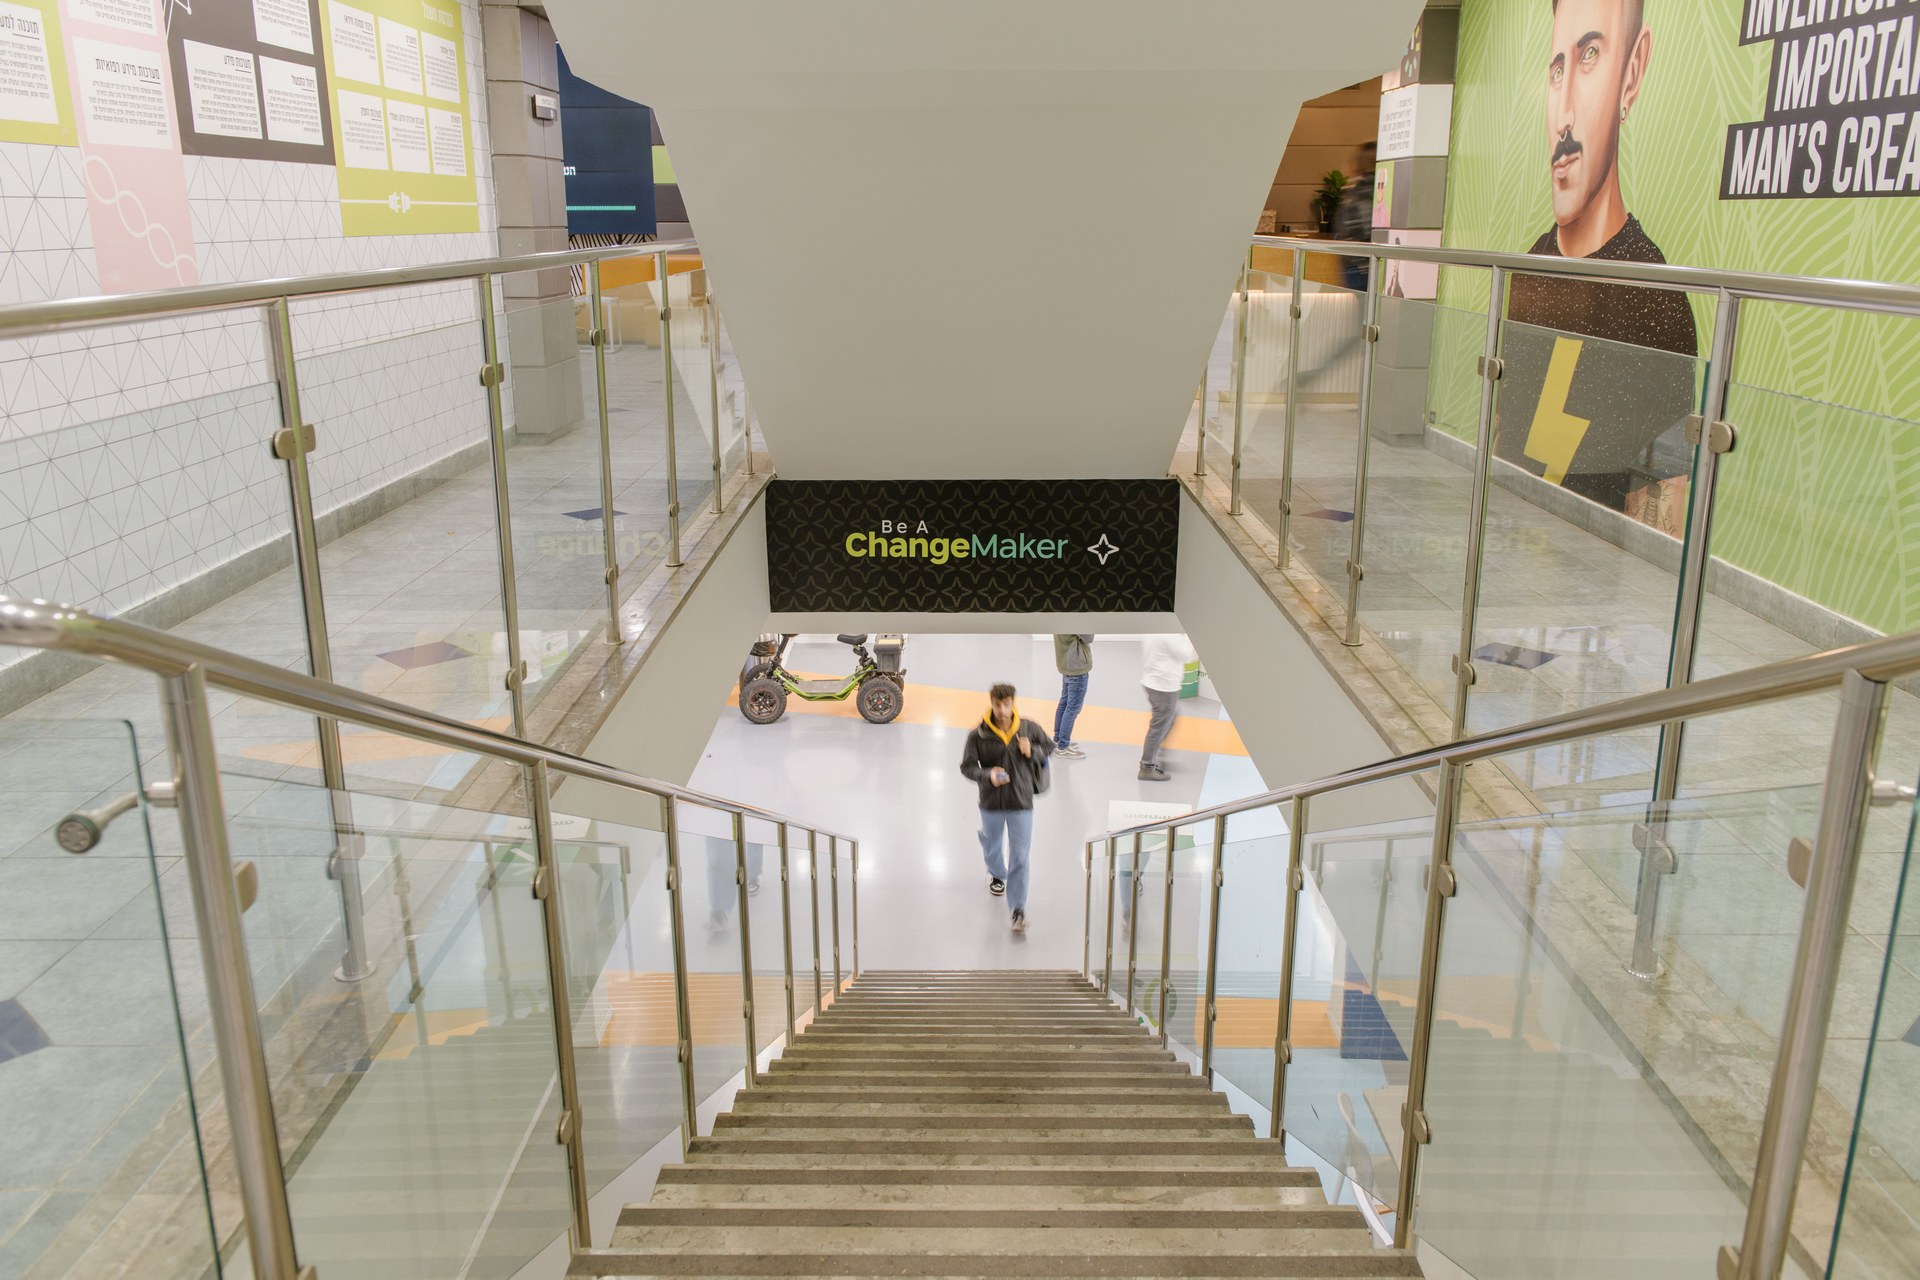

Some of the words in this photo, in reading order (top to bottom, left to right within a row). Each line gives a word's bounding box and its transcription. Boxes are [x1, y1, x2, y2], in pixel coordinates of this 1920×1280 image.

[95, 58, 121, 74] רפואיות
[121, 63, 137, 76] מידע
[138, 65, 160, 80] מערכות
[1728, 120, 1827, 195] MAN'S
[1832, 111, 1920, 194] CREA
[881, 520, 908, 534] Be
[916, 520, 929, 534] A
[845, 531, 1069, 565] ChangeMaker
